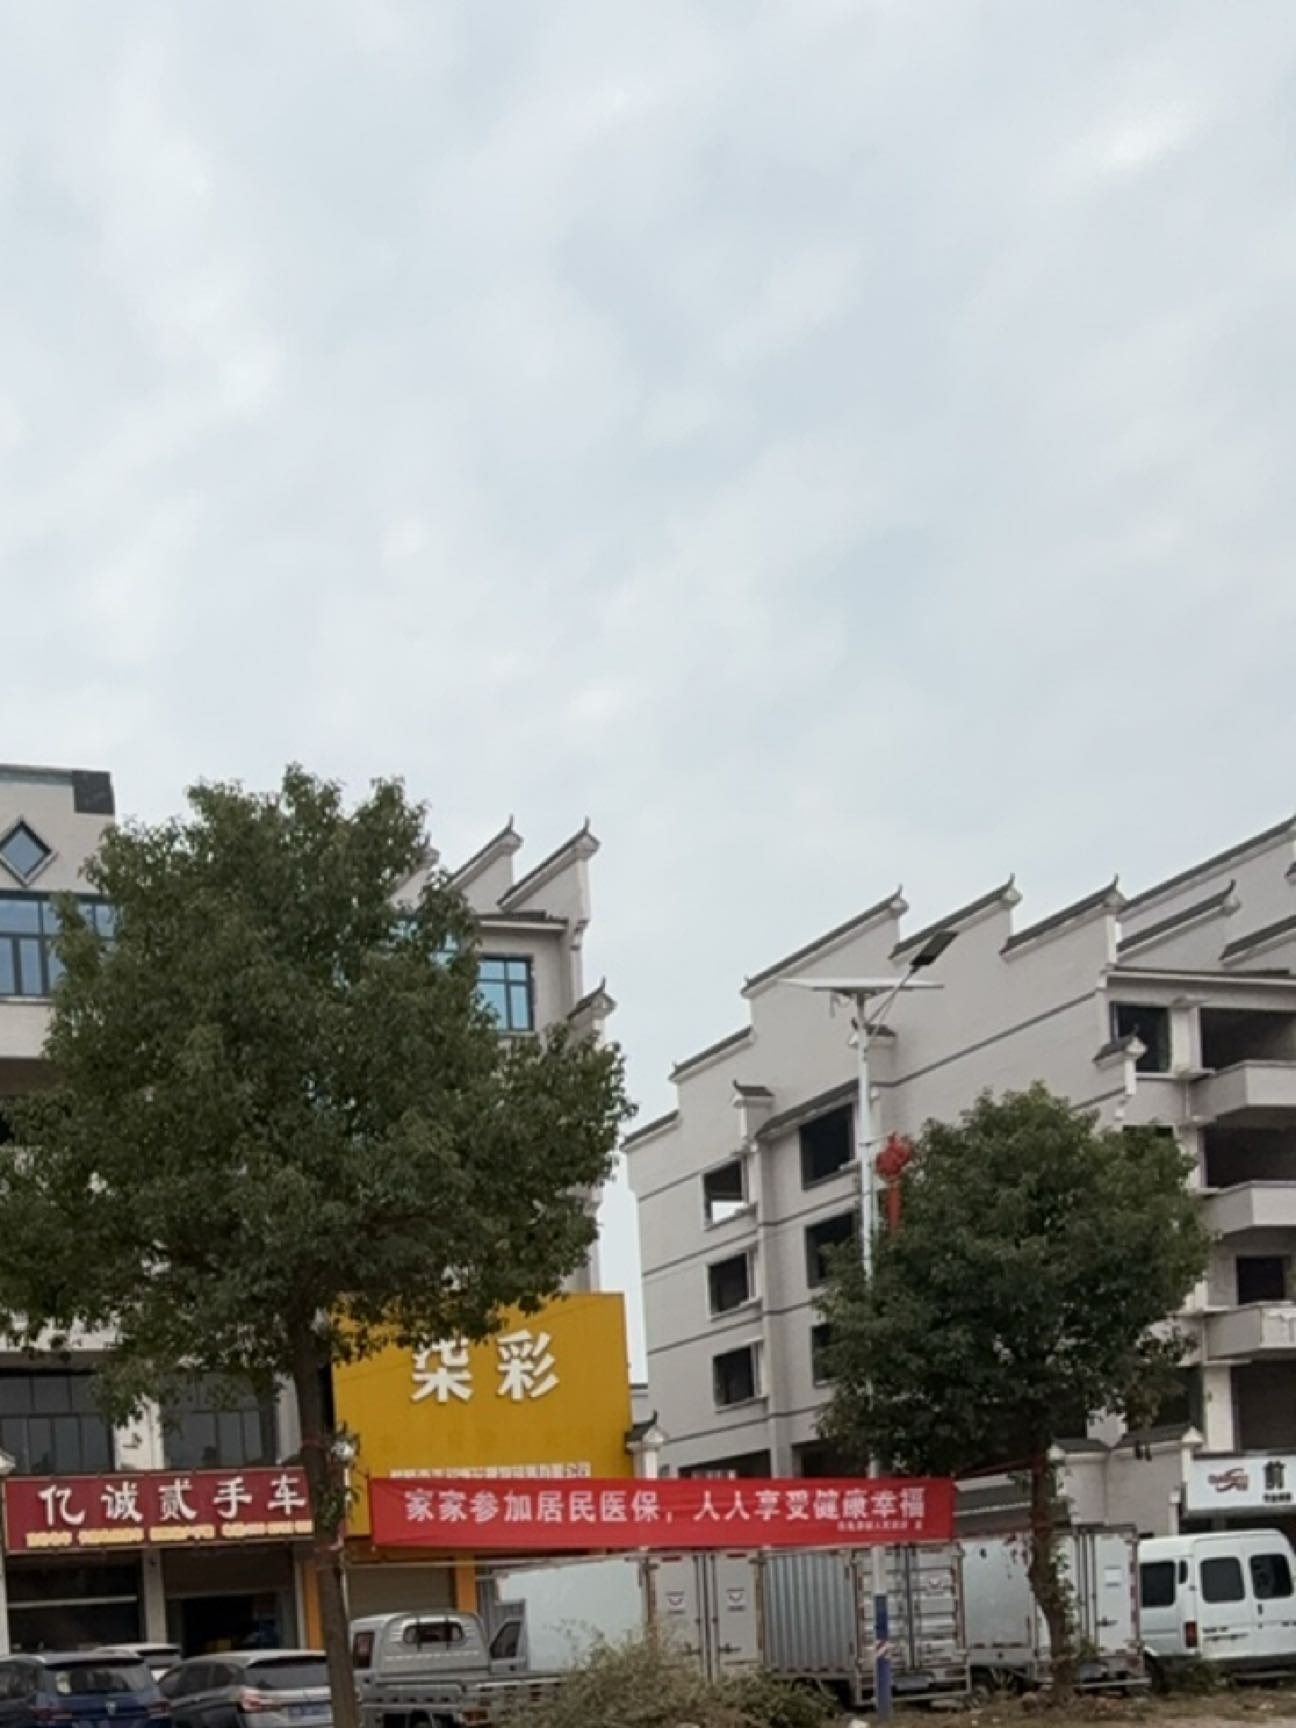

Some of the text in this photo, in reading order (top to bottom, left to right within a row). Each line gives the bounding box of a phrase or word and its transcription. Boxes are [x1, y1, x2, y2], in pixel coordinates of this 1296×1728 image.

[410, 1332, 559, 1402] 柒彩
[38, 1474, 307, 1526] 亿诚贰手车
